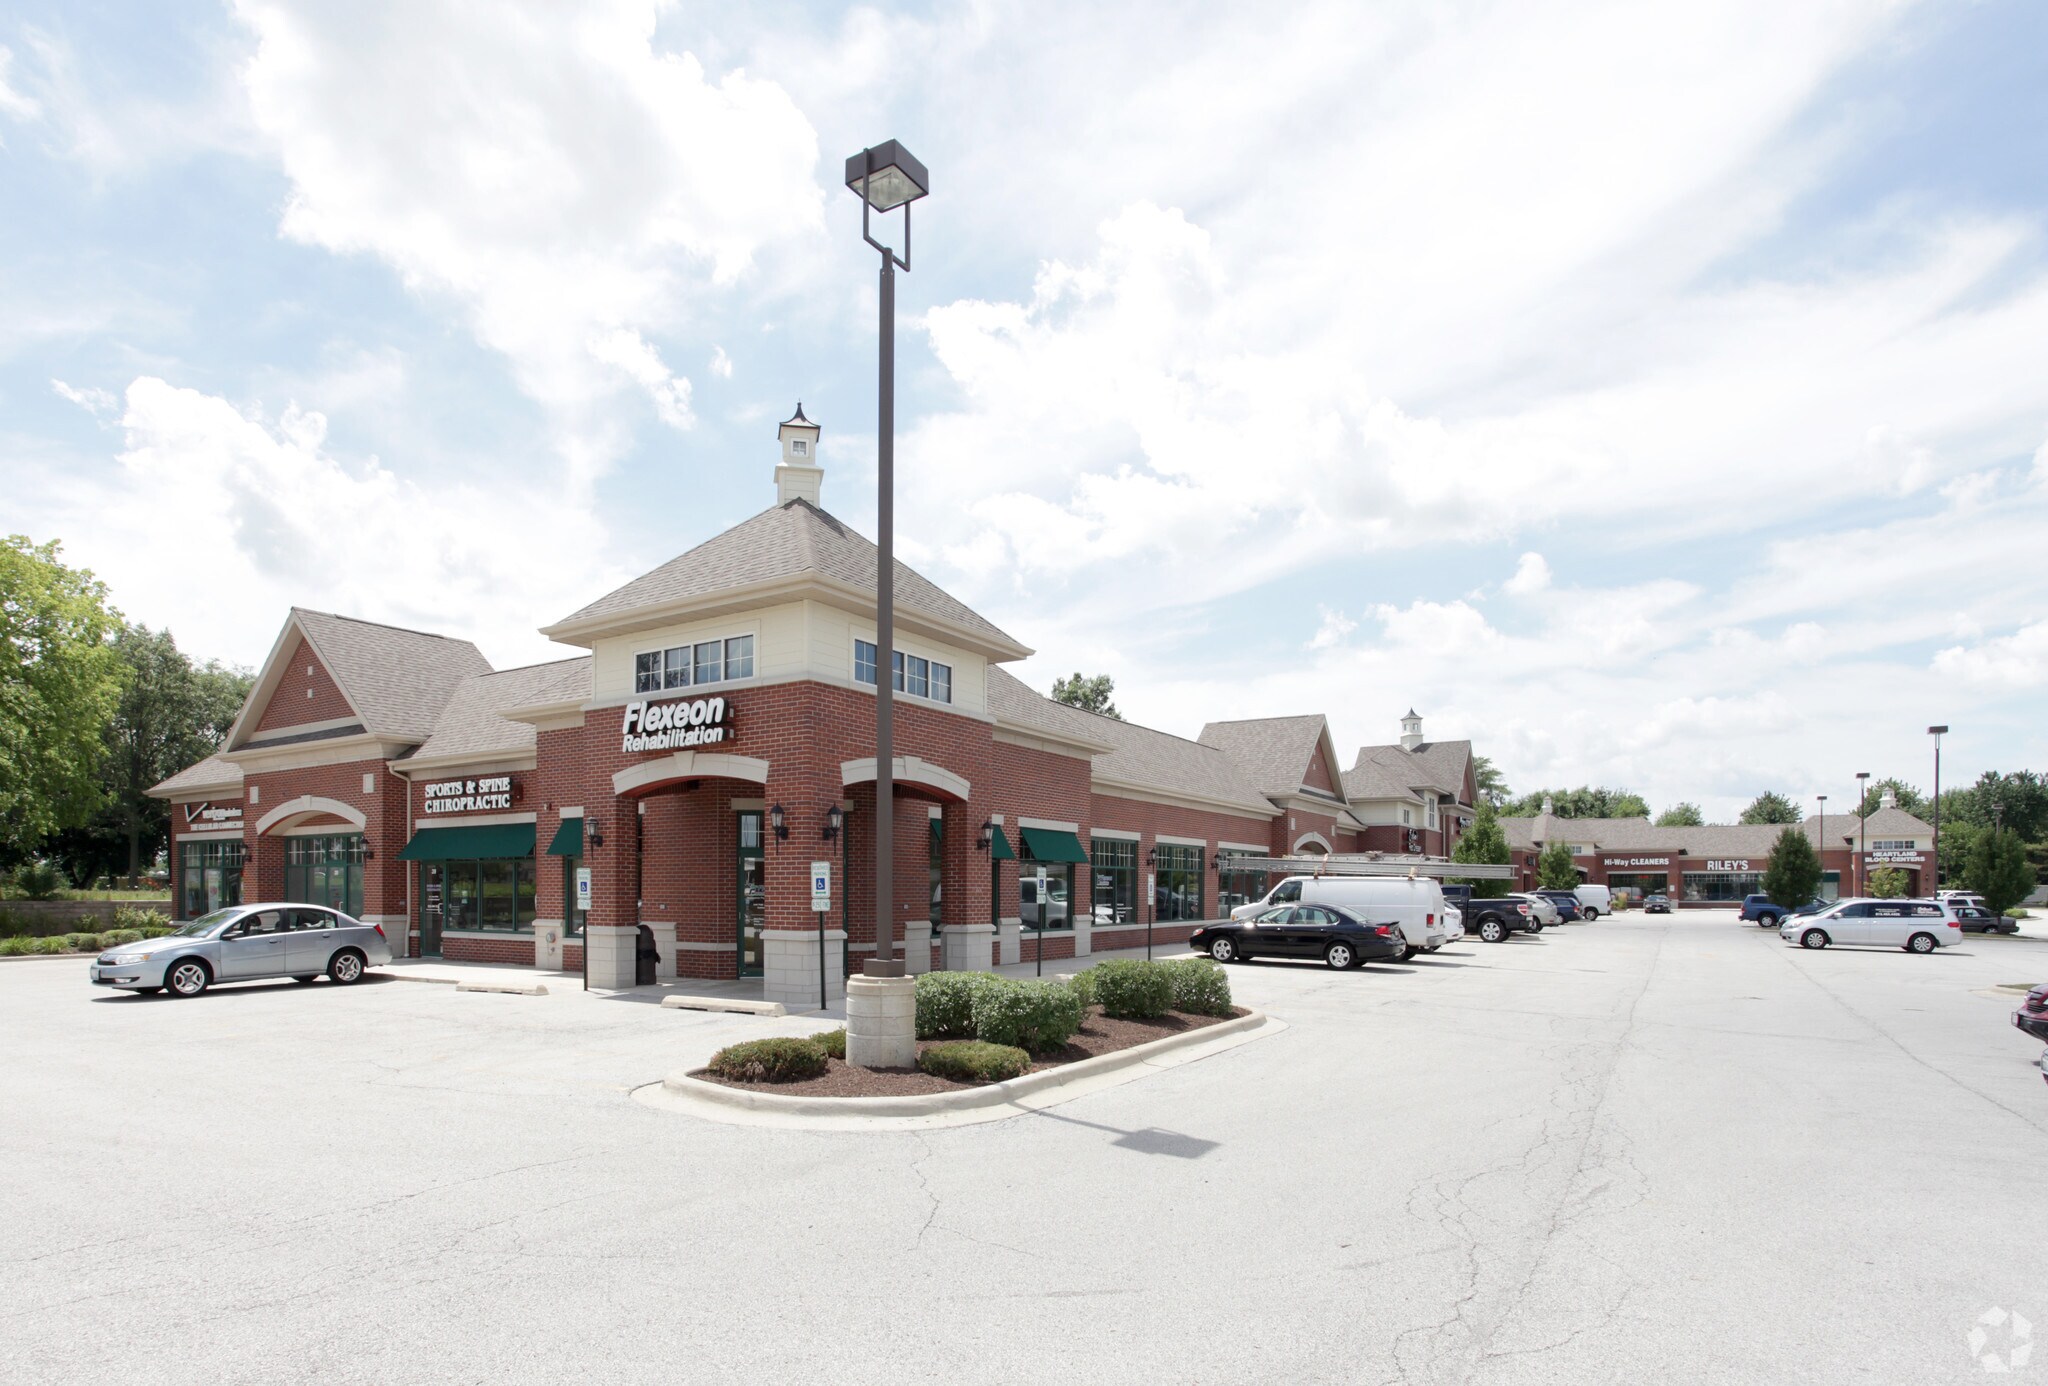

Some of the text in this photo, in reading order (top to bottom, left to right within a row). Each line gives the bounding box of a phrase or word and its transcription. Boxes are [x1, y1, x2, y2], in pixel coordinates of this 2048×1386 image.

[622, 697, 725, 735] Flexeon
[622, 725, 724, 753] Rehabilitation
[424, 776, 511, 798] SPORTS & SPINE
[424, 793, 511, 813] CHIROPRACTIC
[1604, 858, 1670, 867] Hi-Way CLEANERS
[1706, 860, 1749, 871] RILEY'S
